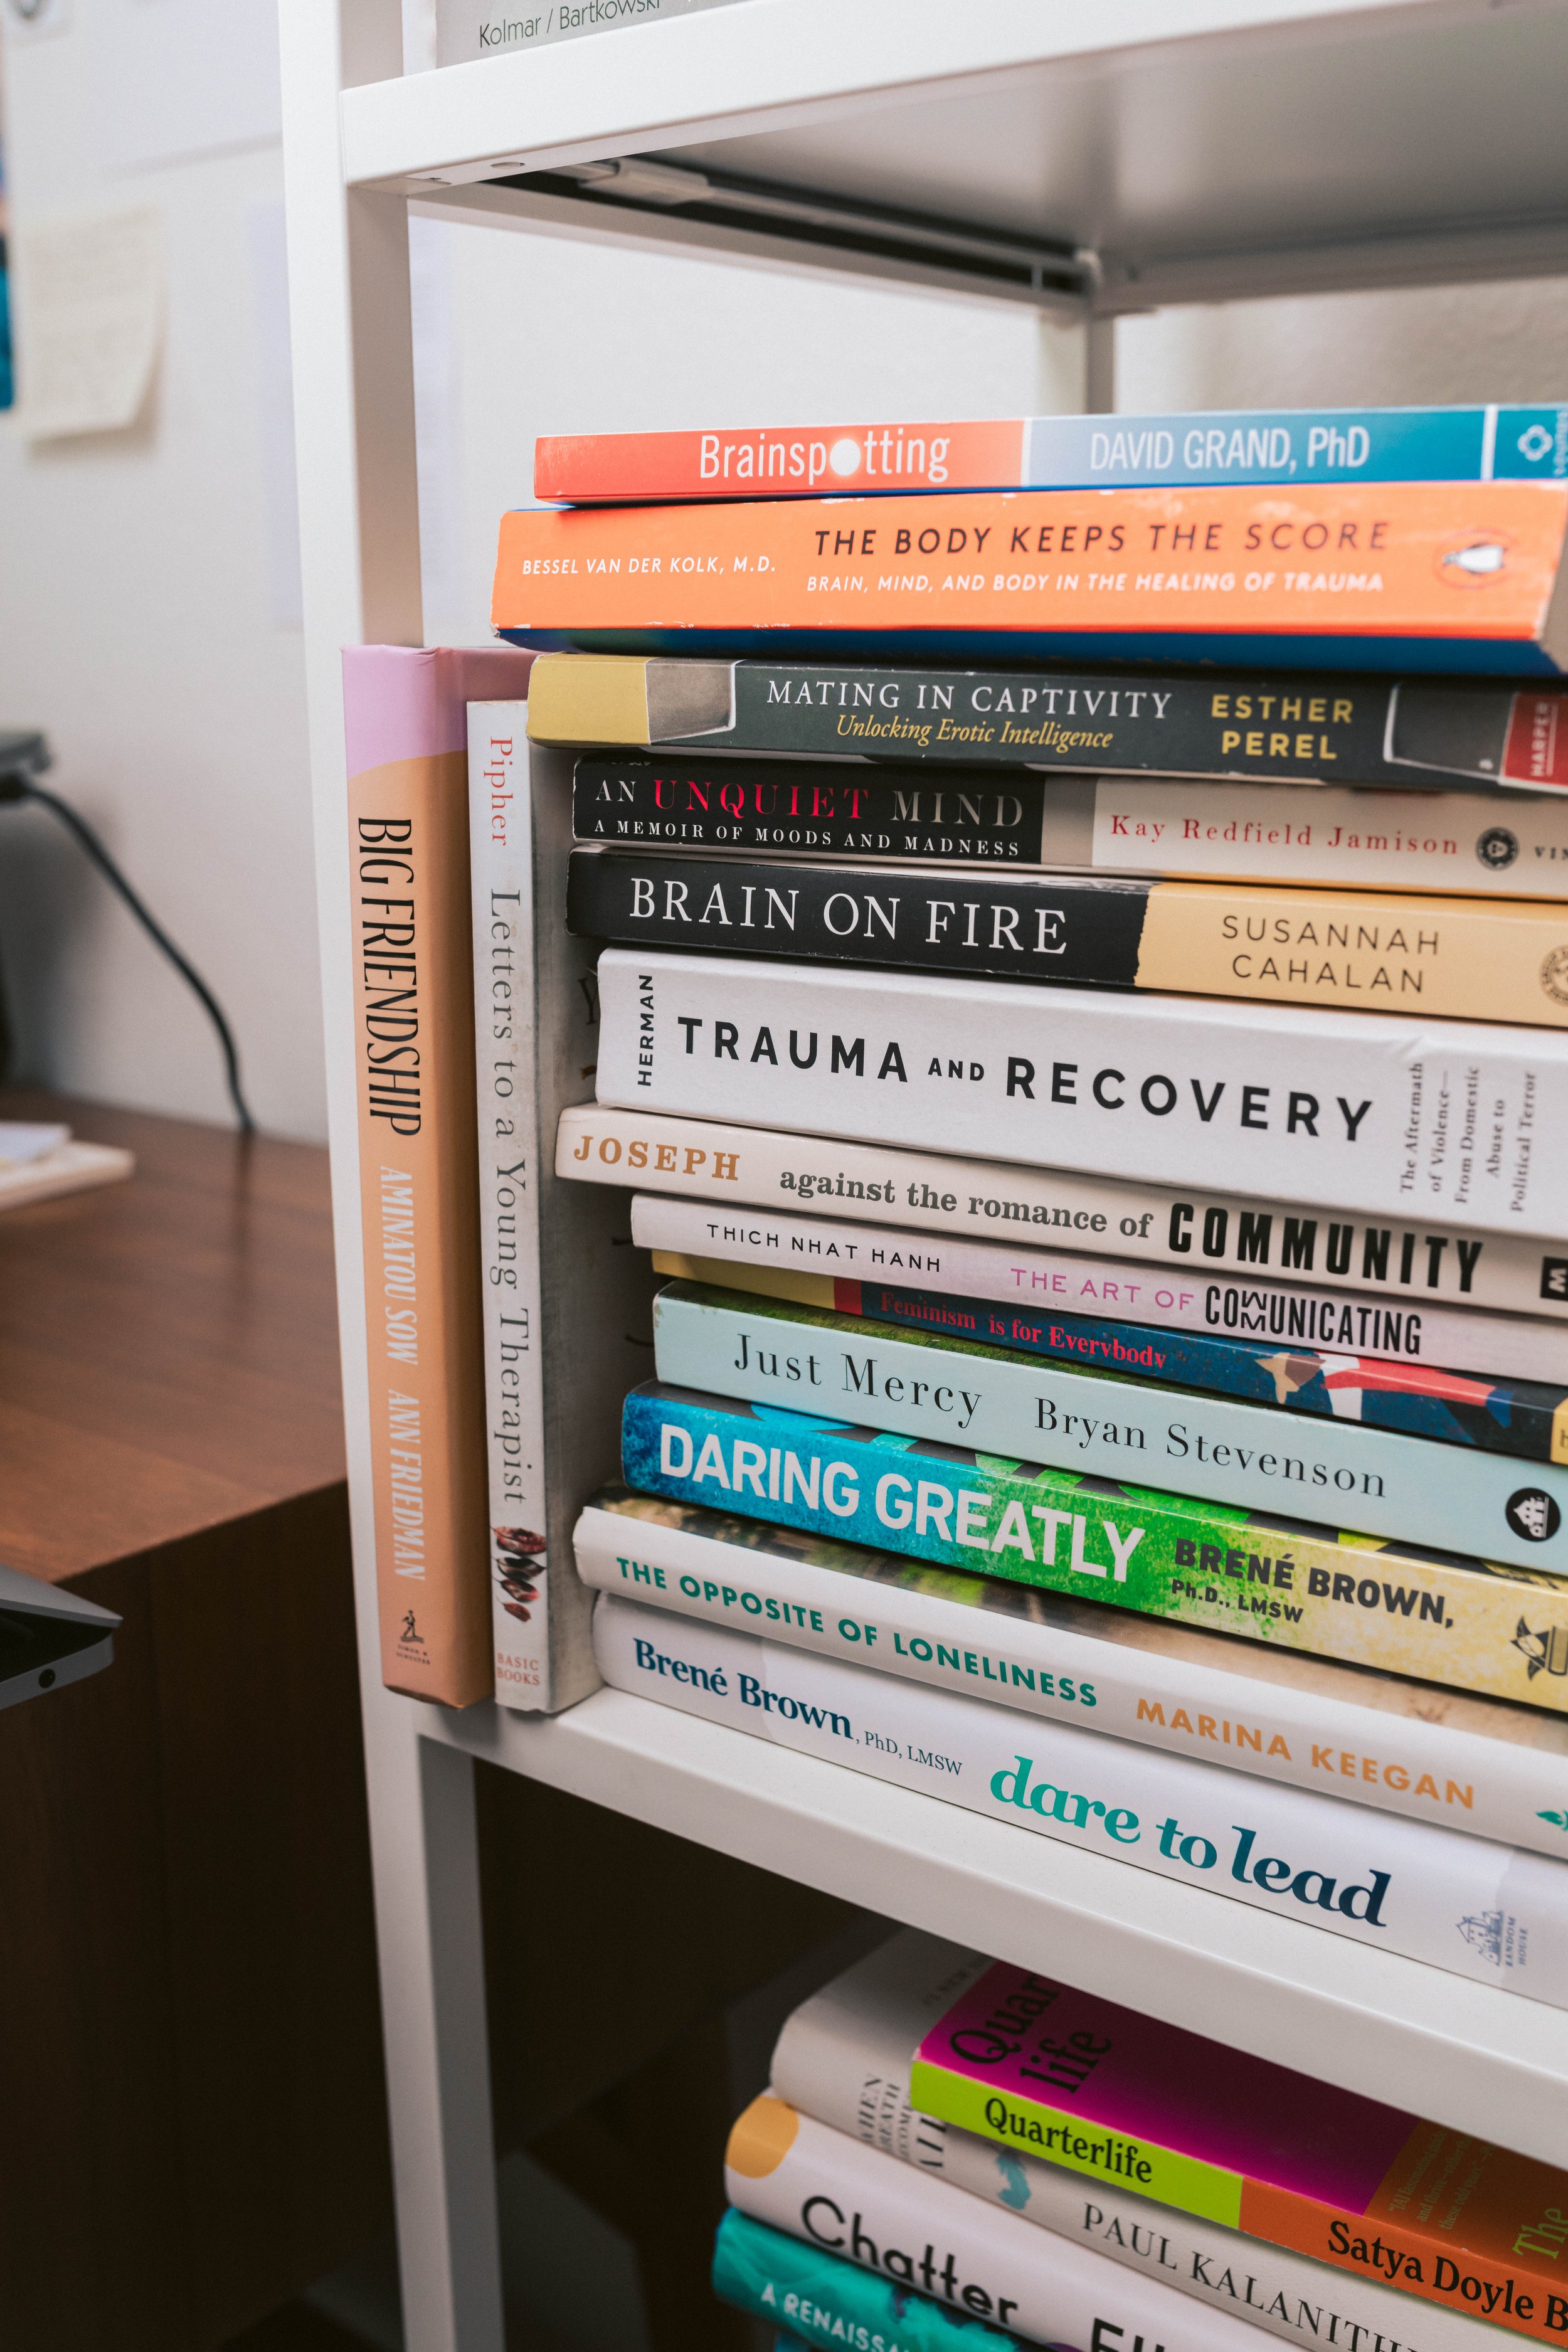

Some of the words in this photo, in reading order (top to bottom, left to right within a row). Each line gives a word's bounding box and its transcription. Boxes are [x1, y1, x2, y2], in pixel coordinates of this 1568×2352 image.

[480, 16, 541, 48] Kolmar
[1090, 432, 1173, 470] DAVID
[1183, 428, 1297, 475] GRAND,
[1308, 426, 1370, 468] PhD
[522, 559, 578, 575] BESSEL
[586, 558, 621, 573] VAN
[628, 557, 661, 573] DER
[670, 556, 724, 574] KOLK,
[734, 555, 776, 572] M.D.
[815, 529, 876, 555] THE
[895, 527, 991, 554] BODY
[1011, 524, 1126, 553] KEEPS
[1148, 524, 1223, 551] THE
[1244, 521, 1390, 551] SCORE
[808, 576, 869, 593] BRAIN,
[878, 575, 933, 593] MIND,
[943, 575, 985, 591] AND
[992, 574, 1049, 591] BODY
[1056, 575, 1078, 591] IN
[1088, 574, 1126, 591] THE
[1135, 573, 1236, 591] HEALING
[1244, 573, 1276, 591] OF
[1284, 573, 1383, 591] TRAUMA
[767, 680, 899, 710] MATING
[917, 685, 955, 710] IN
[970, 686, 1172, 720] CAPTIVITY
[1211, 694, 1353, 724] ESTHER
[837, 714, 931, 748] Unlocking
[936, 717, 995, 743] Erotic
[999, 719, 1113, 753] Intelligence
[1221, 731, 1338, 760] PEREL
[483, 736, 514, 848] Pipher
[595, 780, 637, 803] AN
[654, 779, 869, 819] UNQUIET
[891, 790, 1024, 827] MIND
[357, 818, 415, 885] BIG
[595, 820, 605, 832] A
[617, 820, 704, 838] MEMOIR
[716, 825, 742, 841] OF
[755, 827, 832, 846] MOODS
[844, 832, 890, 849] AND
[904, 836, 1019, 857] MADNESS
[1110, 815, 1165, 842] Kay
[1183, 819, 1312, 845] Redfield
[1327, 826, 1458, 855] Jamison
[629, 878, 799, 931] BRAIN
[824, 893, 900, 940] ON
[926, 901, 1067, 955] FIRE
[1222, 915, 1439, 955] SUSANNAH
[490, 889, 521, 1041] Letters
[1232, 955, 1424, 993] CAHALAN
[361, 897, 422, 1136] FRIENDSHIP
[638, 975, 654, 1087] HERMAN
[495, 1059, 517, 1098] to
[677, 1017, 908, 1083] TRAUMA
[928, 1058, 985, 1081] AND
[1006, 1057, 1372, 1142] RECOVERY
[1404, 1063, 1422, 1153] Aftermath
[1494, 1099, 1505, 1117] to
[1518, 1072, 1535, 1130] Terror
[497, 1119, 517, 1139] a
[1460, 1067, 1478, 1150] Domestic
[573, 1135, 740, 1181] JOSEPH
[1400, 1160, 1416, 1193] The
[1454, 1158, 1471, 1203] From
[1486, 1124, 1503, 1178] Abuse
[1510, 1137, 1530, 1212] Political
[1428, 1171, 1441, 1192] of
[379, 1165, 416, 1302] AMINATOU
[490, 1158, 527, 1290] Young
[707, 1224, 779, 1248] THICH
[792, 1237, 857, 1259] NHAT
[872, 1249, 941, 1273] HANH
[780, 1170, 896, 1204] against
[907, 1184, 957, 1211] the
[968, 1196, 1107, 1232] romance
[1120, 1212, 1153, 1238] of
[1168, 1202, 1483, 1293] COMMUNITY
[1010, 1268, 1066, 1293] THE
[1080, 1279, 1140, 1303] ART
[1155, 1289, 1194, 1312] OF
[384, 1306, 419, 1366] SOW
[880, 1291, 975, 1330] Feminism
[989, 1313, 1005, 1335] is
[1011, 1318, 1042, 1344] for
[1049, 1326, 1167, 1369] Everybody
[495, 1308, 530, 1505] Therapist
[735, 1333, 821, 1387] Just
[841, 1353, 982, 1429] Mercy
[387, 1388, 421, 1444] ANN
[1034, 1396, 1147, 1449] Bryan
[1167, 1422, 1387, 1498] Stevenson
[390, 1448, 425, 1582] FRIEDMAN
[660, 1423, 860, 1518] DARING
[876, 1472, 1145, 1584] GREATLY
[1174, 1537, 1295, 1591] BRENÉ
[1308, 1567, 1453, 1629] BROWN,
[1238, 1597, 1303, 1624] LMSW
[617, 1557, 667, 1590] THE
[679, 1575, 824, 1632] OPPOSITE
[839, 1618, 877, 1647] OF
[894, 1632, 1097, 1707] LONELINESS
[496, 1668, 540, 1686] BOOKS
[497, 1653, 539, 1671] BASIC
[633, 1638, 728, 1696] Brené
[864, 1730, 903, 1759] PhD,
[907, 1745, 963, 1776] LMSW
[1136, 1698, 1291, 1761] MARINA
[1311, 1744, 1475, 1810] KEEGAN
[990, 1755, 1140, 1843] dare
[1156, 1818, 1217, 1869] to
[1231, 1826, 1392, 1927] lead
[1020, 2030, 1112, 2094] life
[985, 2097, 1152, 2184] Quarterlife
[801, 2196, 1017, 2326] Chatter
[1083, 2202, 1177, 2270] PAUL
[761, 2284, 776, 2307] A
[1328, 2221, 1424, 2284] Satya
[1433, 2255, 1534, 2318] Doyle
